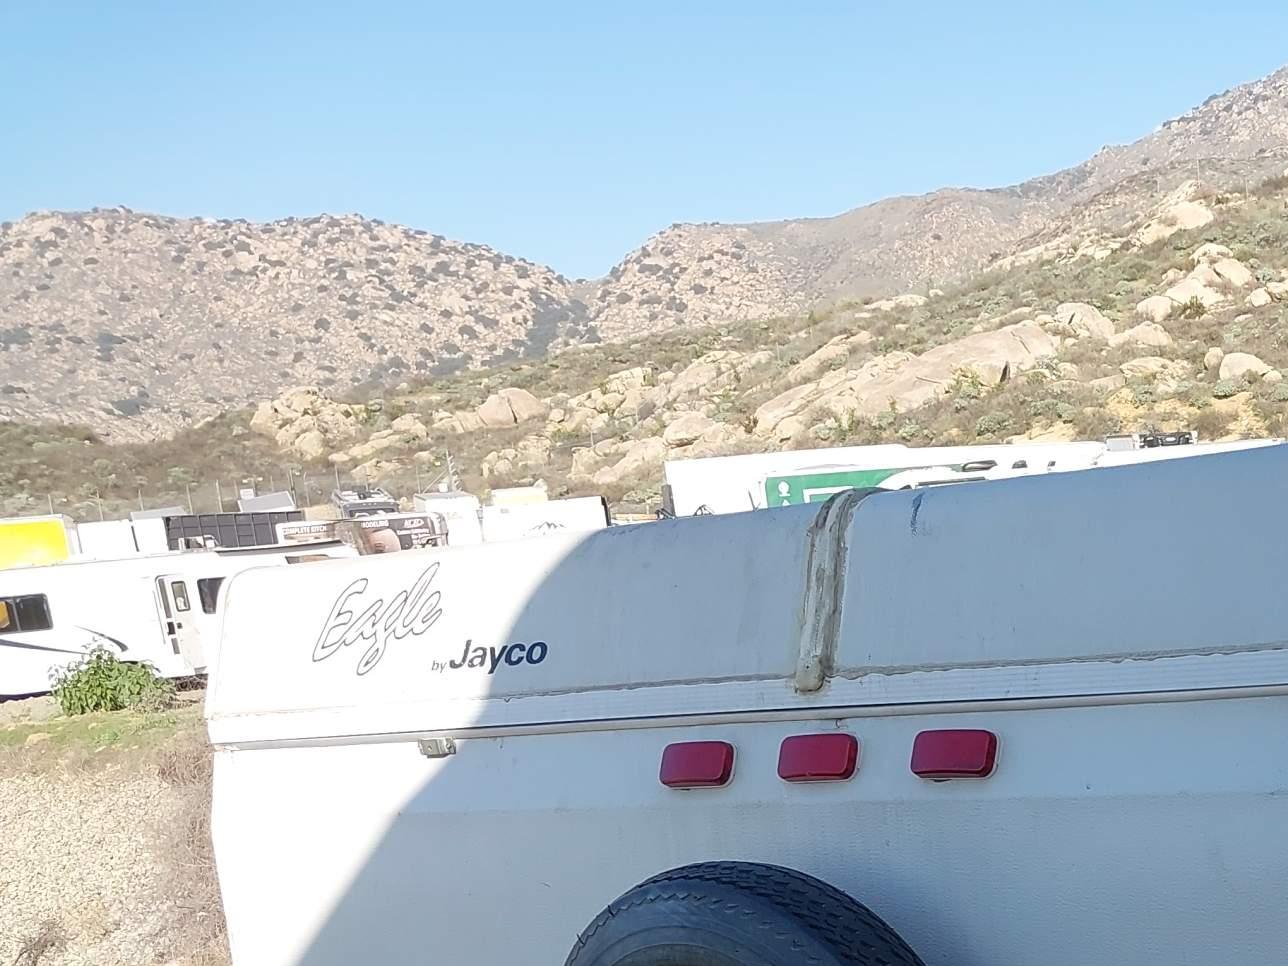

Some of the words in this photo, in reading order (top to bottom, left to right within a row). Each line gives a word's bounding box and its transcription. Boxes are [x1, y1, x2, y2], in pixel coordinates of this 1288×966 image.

[312, 562, 442, 676] Eagle
[431, 659, 447, 671] by
[449, 639, 548, 675] Jayco
